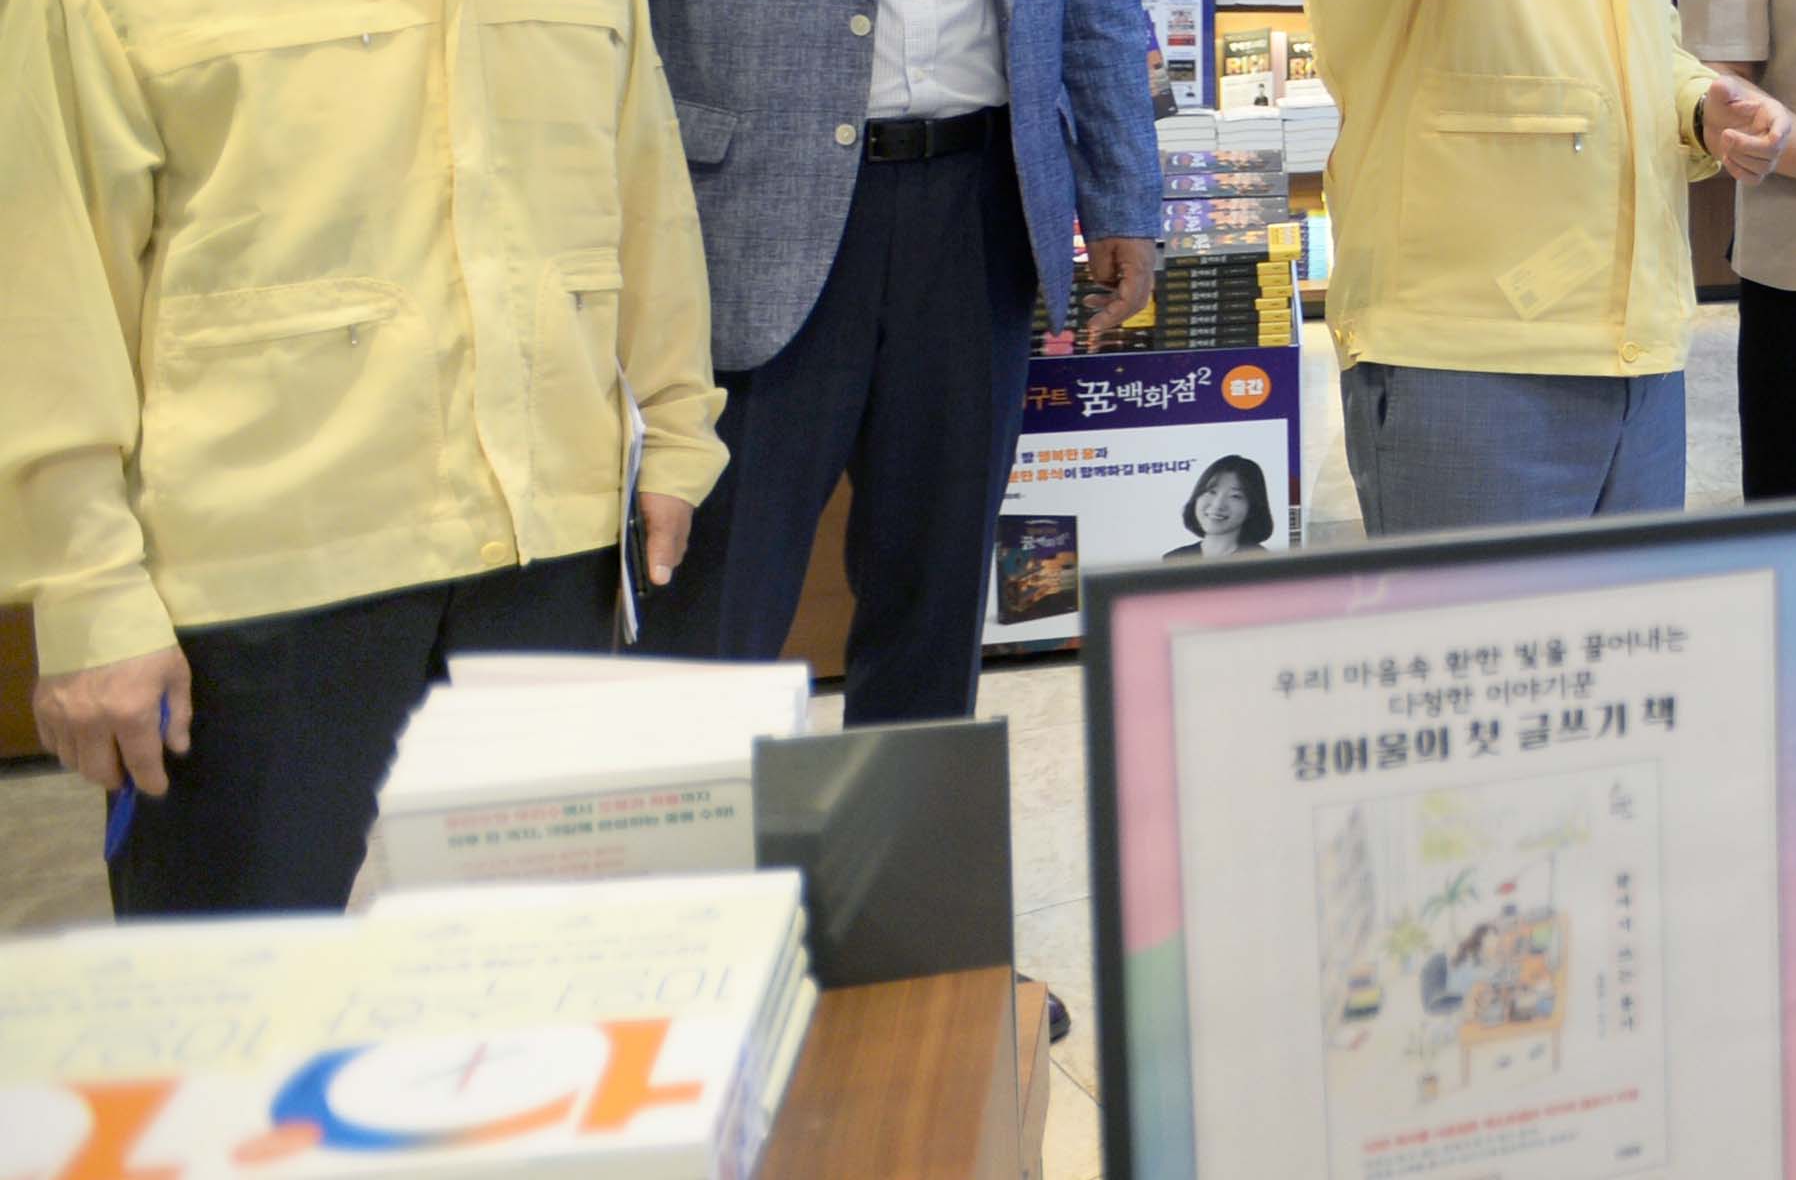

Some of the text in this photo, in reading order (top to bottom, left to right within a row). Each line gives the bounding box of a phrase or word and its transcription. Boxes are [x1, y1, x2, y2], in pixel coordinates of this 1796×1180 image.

[1023, 386, 1072, 411] 구트
[1274, 664, 1331, 697] 우리
[1343, 656, 1432, 688] 마음속
[1444, 644, 1502, 677] 환한
[1514, 636, 1567, 669] 빛을
[1388, 669, 1595, 719] 다정한 이야기꾼
[1292, 695, 1677, 781] 정여울의 첫 글쓰기 책
